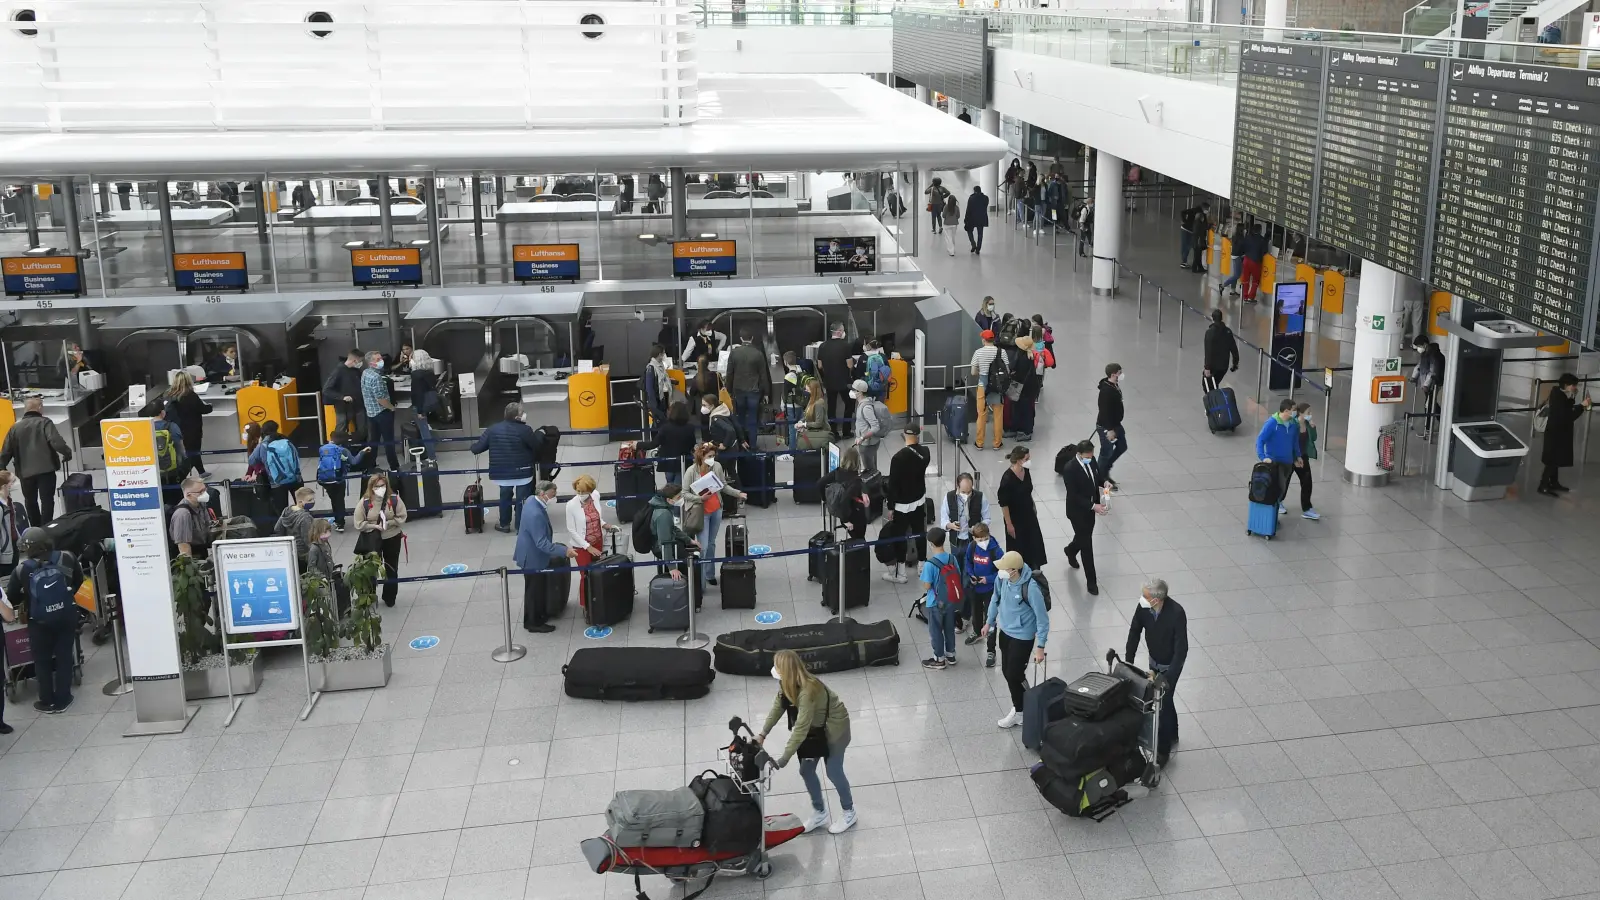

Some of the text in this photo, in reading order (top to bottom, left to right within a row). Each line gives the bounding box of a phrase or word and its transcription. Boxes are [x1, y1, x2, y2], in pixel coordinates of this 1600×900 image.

[1342, 52, 1399, 66] Abflug Departures Terminal 2
[1468, 64, 1549, 82] Abflug Departures Terminal 2
[1587, 76, 1600, 87] 10:3
[1565, 122, 1592, 135] Check-in
[1470, 131, 1493, 142] Amsterdam
[1562, 148, 1589, 161] Check-in
[1564, 135, 1591, 148] Check-in
[1561, 160, 1588, 174] Check-in
[1560, 173, 1586, 186] Check-in
[1466, 176, 1481, 187] Zürich
[1557, 198, 1583, 212] Check-in
[1558, 185, 1585, 199] Check-in
[1555, 210, 1582, 225] Check-in
[1554, 223, 1580, 237] Check-in
[1506, 234, 1520, 245] 12:25
[1551, 247, 1577, 262] Check-in
[1553, 235, 1579, 250] Check-in
[22, 262, 61, 270] Lufthansa
[1550, 259, 1576, 275] Check-in
[1549, 271, 1575, 287] Check-in
[1547, 283, 1573, 300] Check-in
[37, 300, 52, 308] 455
[1546, 296, 1572, 312] Check-in
[1545, 308, 1570, 324] Check-in
[1543, 320, 1569, 337] Check-in
